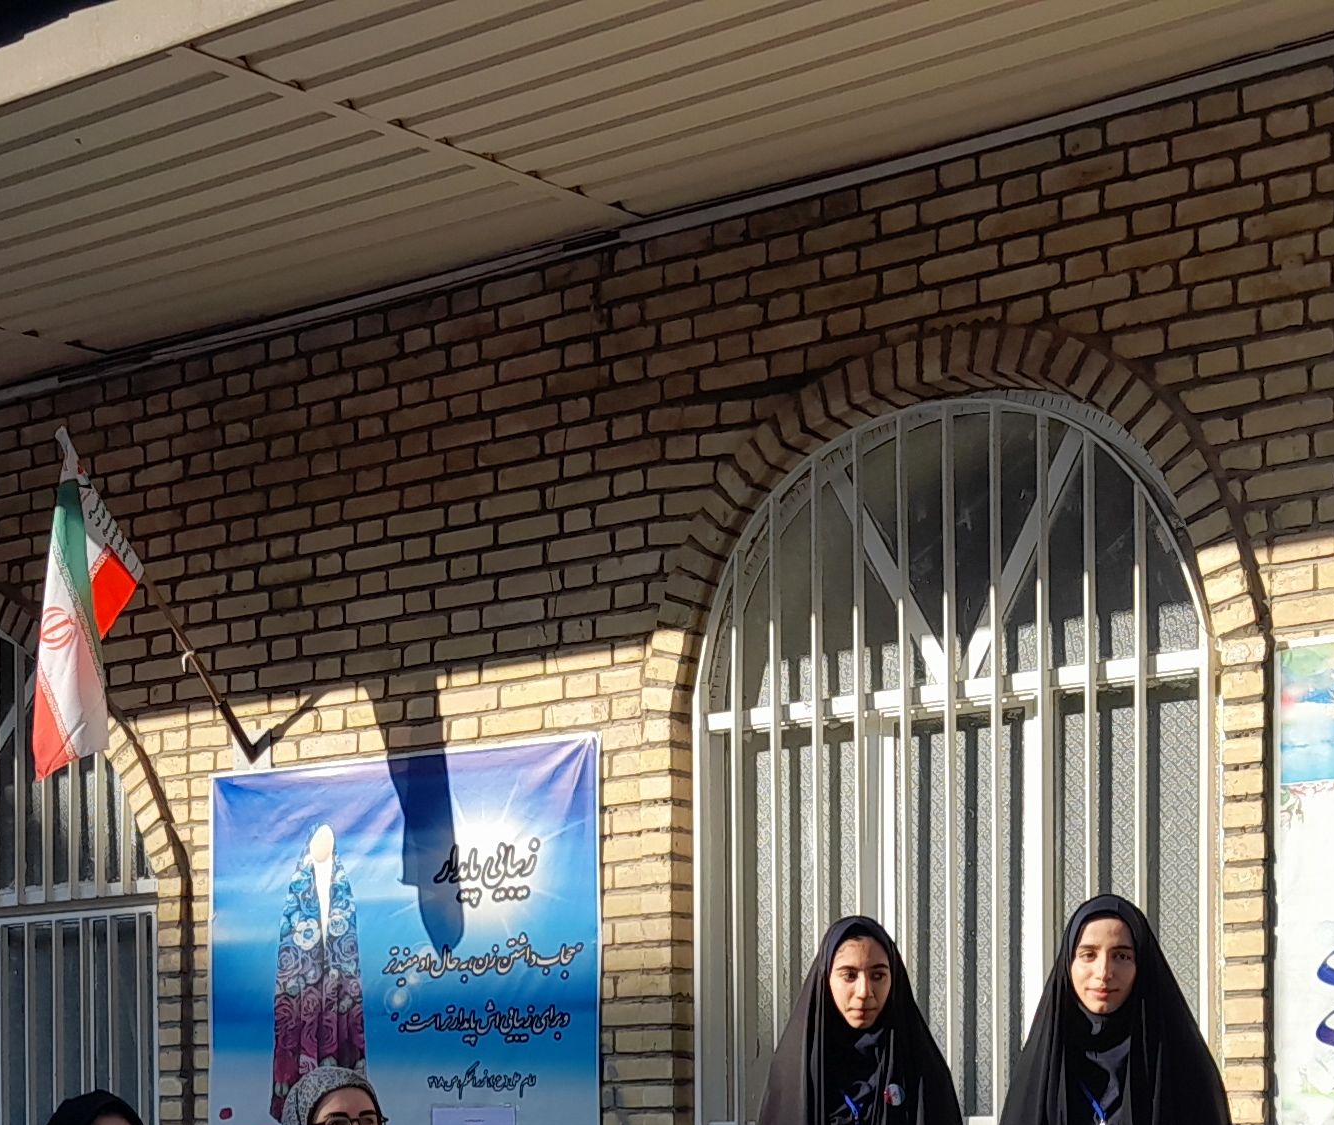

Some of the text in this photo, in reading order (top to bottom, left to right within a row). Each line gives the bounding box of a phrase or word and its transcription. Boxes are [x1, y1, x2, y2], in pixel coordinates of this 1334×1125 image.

[434, 838, 541, 908] زیبایی پایدار
[429, 944, 460, 977] حال
[497, 932, 537, 975] داشتن
[500, 1004, 535, 1044] زیبایی
[532, 1003, 566, 1040] برای
